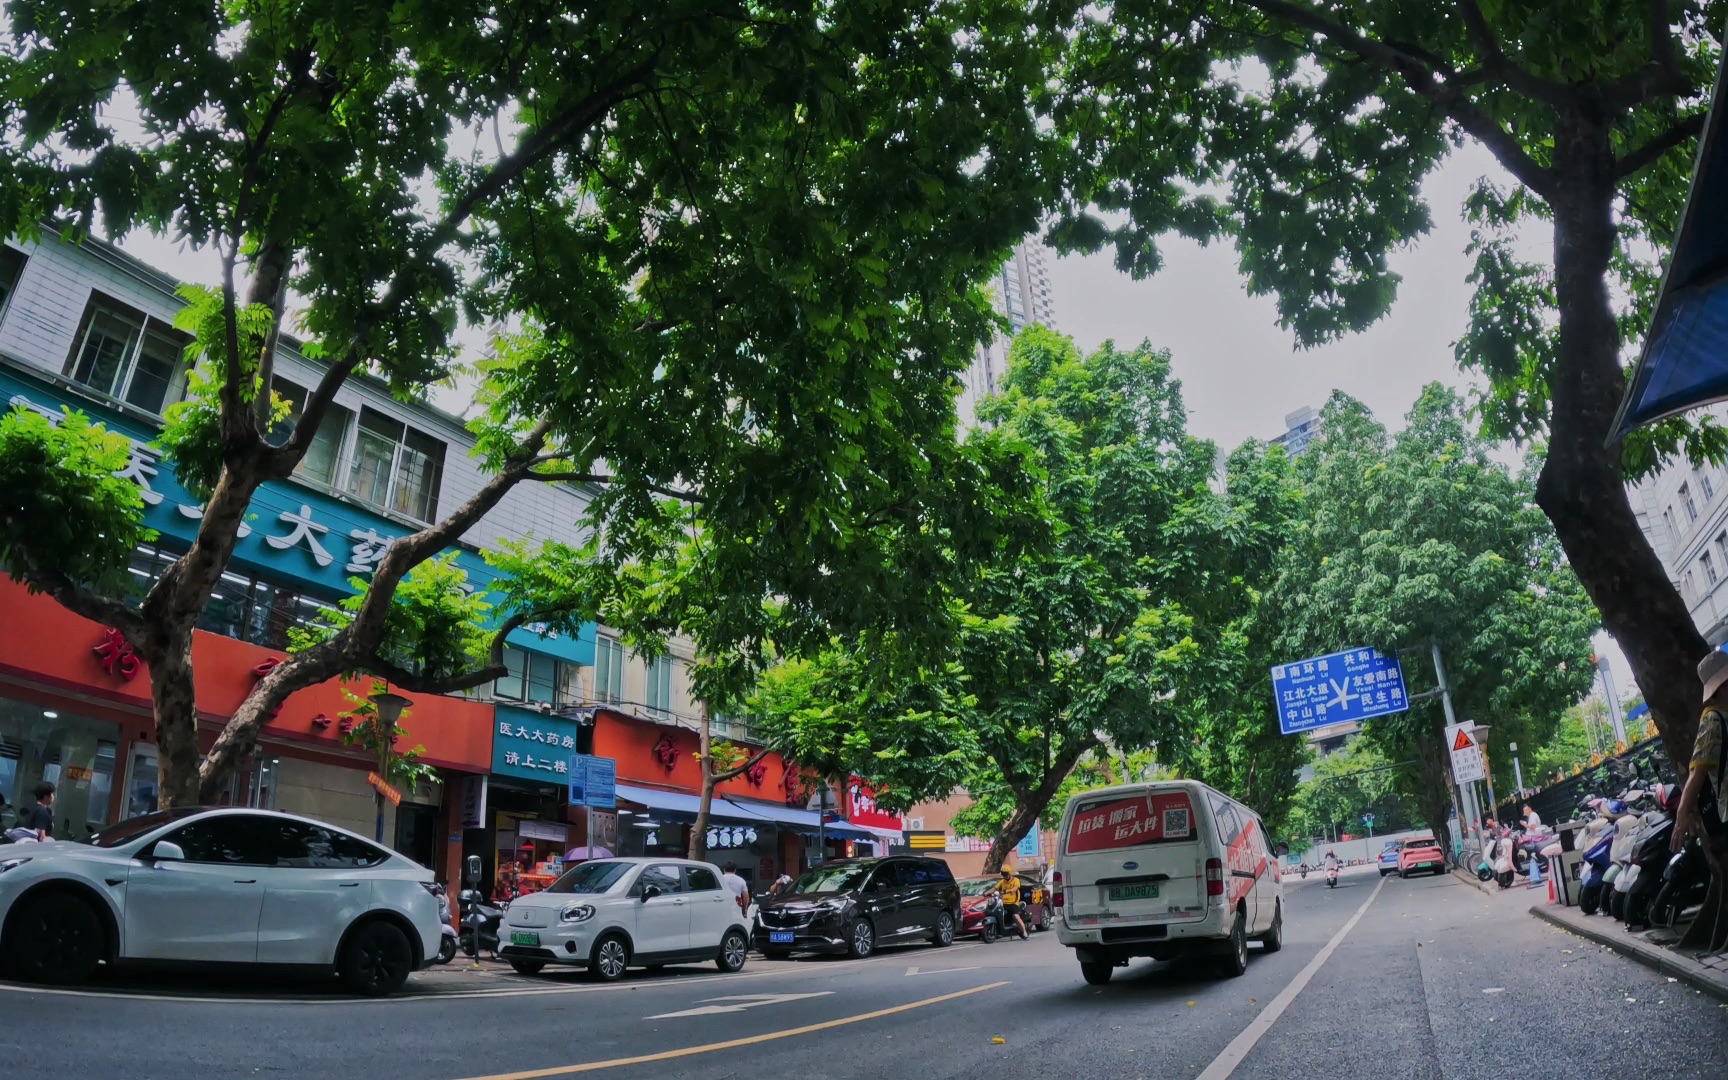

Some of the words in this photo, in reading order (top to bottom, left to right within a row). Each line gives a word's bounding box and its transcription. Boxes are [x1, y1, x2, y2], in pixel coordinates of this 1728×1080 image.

[1289, 660, 1329, 678] 南环路
[1346, 663, 1370, 672] Gonghe
[1353, 667, 1399, 687] 友爱南路
[1283, 683, 1329, 702] 江北大道
[1361, 688, 1402, 706] 民生路
[1287, 703, 1327, 721] 中山路
[1363, 703, 1389, 713] Minsheng
[500, 722, 575, 749] 医大大药房
[505, 751, 568, 774] 请上二楼
[576, 757, 583, 768] P
[1115, 815, 1158, 840] 运大件
